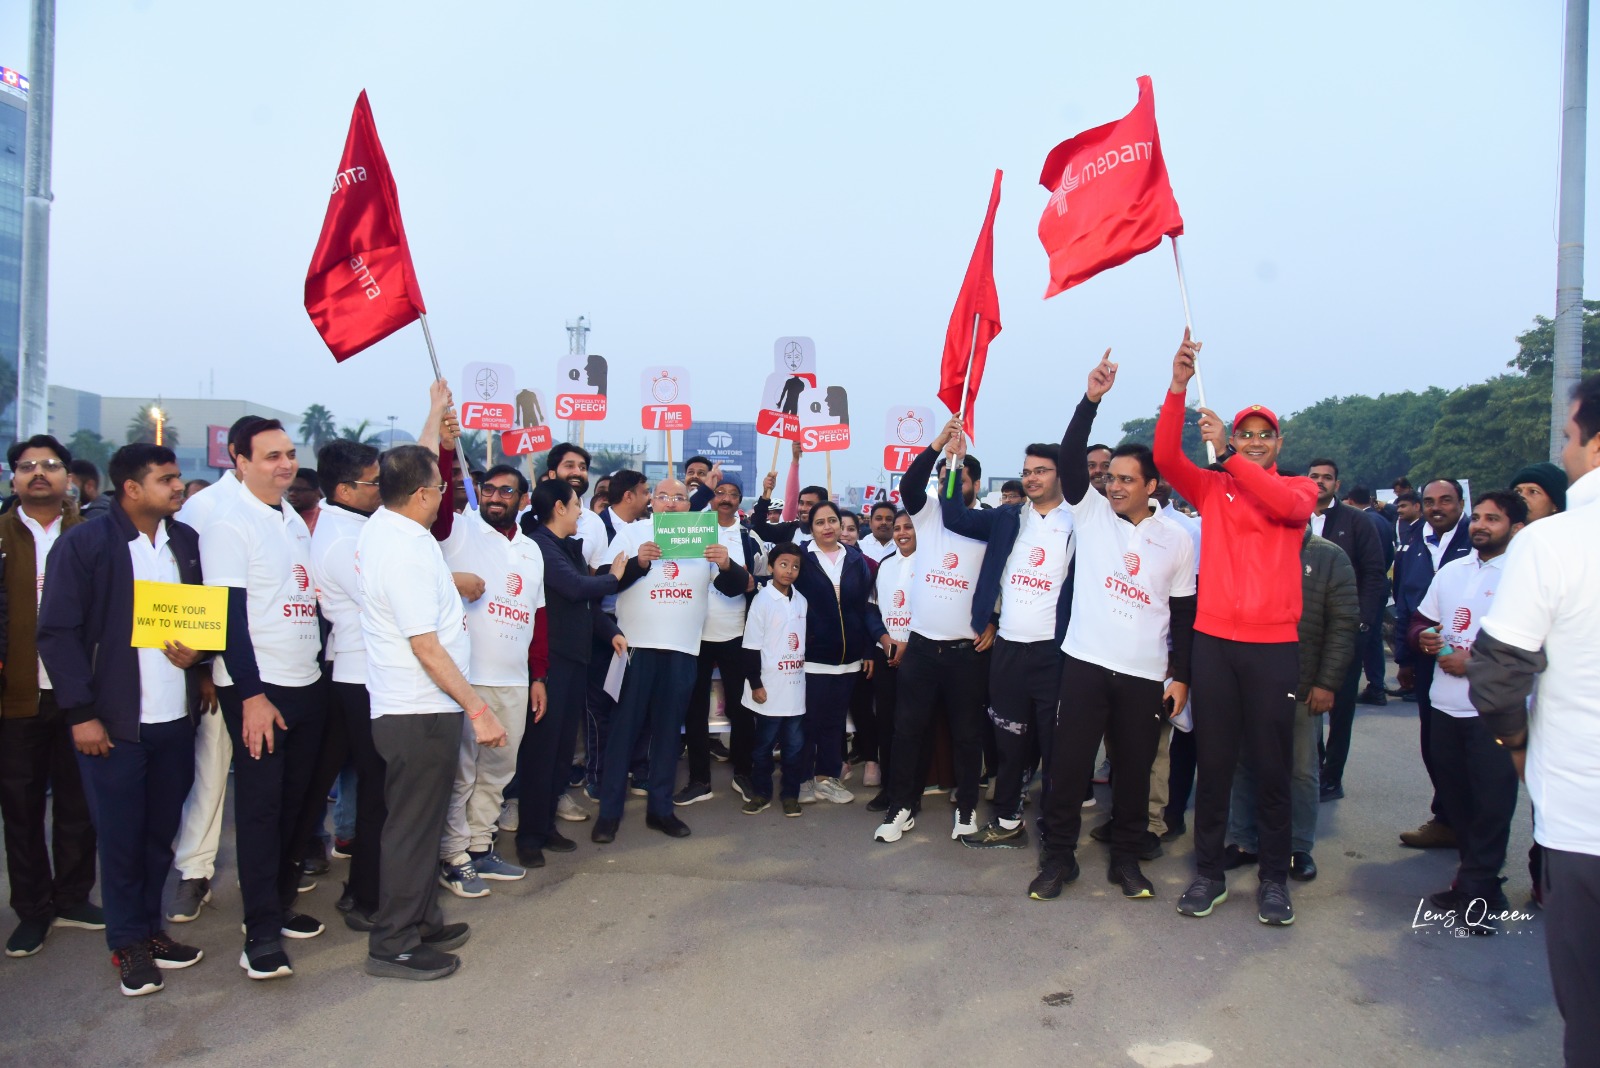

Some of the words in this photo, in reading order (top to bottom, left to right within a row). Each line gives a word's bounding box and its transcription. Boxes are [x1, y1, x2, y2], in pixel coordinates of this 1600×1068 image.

[558, 397, 606, 417] SPEECH
[465, 404, 503, 426] FACE
[651, 407, 683, 429] TIME
[767, 417, 798, 437] ARM
[516, 432, 546, 454] ARM
[802, 429, 849, 450] SPEECH
[658, 526, 676, 534] WALK
[687, 526, 714, 534] BREATHE
[930, 568, 953, 577] WORLD
[1016, 568, 1038, 577] WORLD
[925, 573, 970, 590] STROKE
[1011, 574, 1053, 592] STROKE
[288, 594, 310, 602] WORLD
[650, 588, 693, 600] STROKE
[1104, 576, 1152, 605] STROKE
[494, 594, 519, 607] WORLD
[1131, 600, 1145, 611] DAY
[152, 603, 178, 614] MOVE
[181, 606, 206, 615] YOUR
[487, 601, 530, 625] STROKE
[1112, 608, 1133, 619] 2025
[137, 617, 156, 627] WAY
[159, 619, 171, 628] TO
[174, 620, 221, 631] WELLNESS
